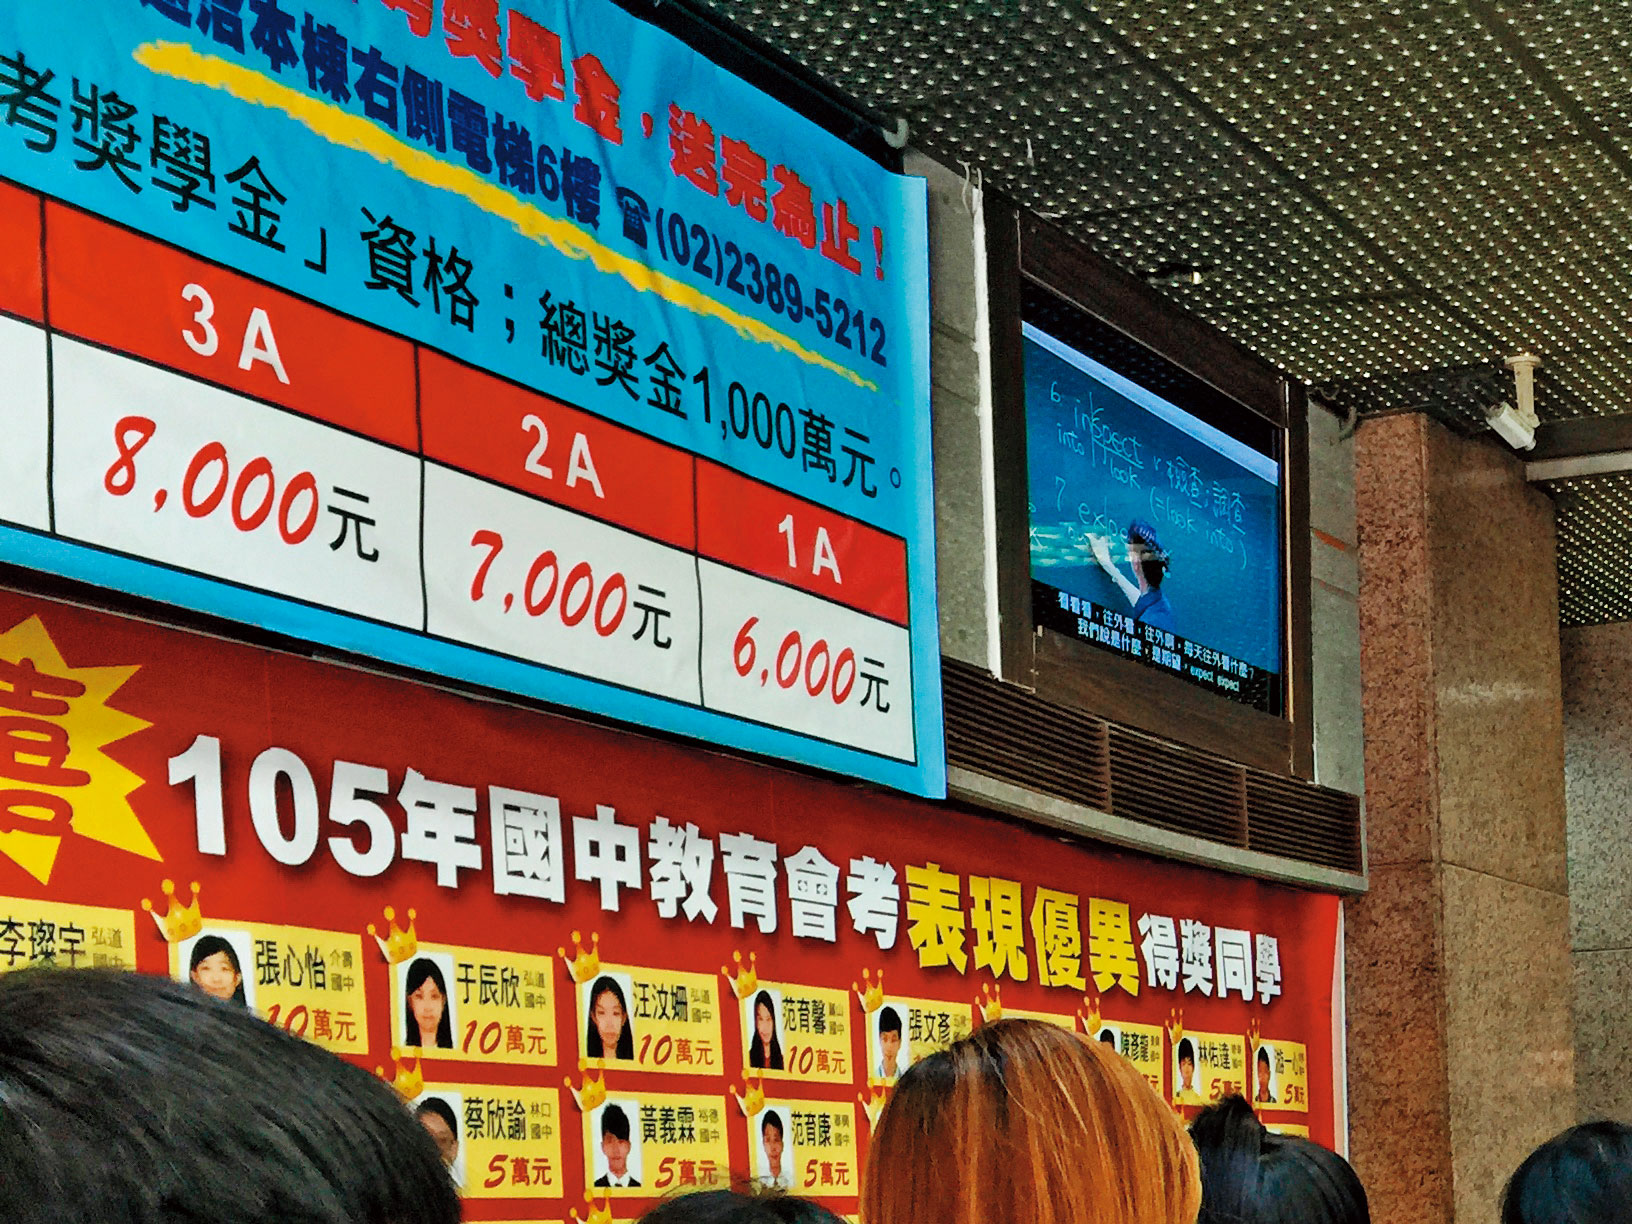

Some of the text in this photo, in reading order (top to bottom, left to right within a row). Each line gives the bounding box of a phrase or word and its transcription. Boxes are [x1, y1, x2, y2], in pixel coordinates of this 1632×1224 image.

[655, 207, 887, 367] (02)2389-5212
[182, 284, 290, 385] 3A
[521, 414, 605, 498] 2A
[103, 416, 380, 564] 8,000元
[778, 513, 844, 585] 1A
[469, 529, 673, 649] 7,000元
[732, 617, 891, 714] 6,000元
[255, 939, 327, 991] 張心怡
[456, 962, 522, 1009] 于辰欣
[267, 1002, 357, 1043] 10萬元
[462, 1020, 549, 1056] 10萬元
[638, 1034, 715, 1066] 10萬元
[787, 1045, 848, 1076] 10萬元
[483, 1154, 553, 1189] 5萬元
[654, 1156, 719, 1189] 5萬元
[803, 1158, 851, 1188] 5萬元
